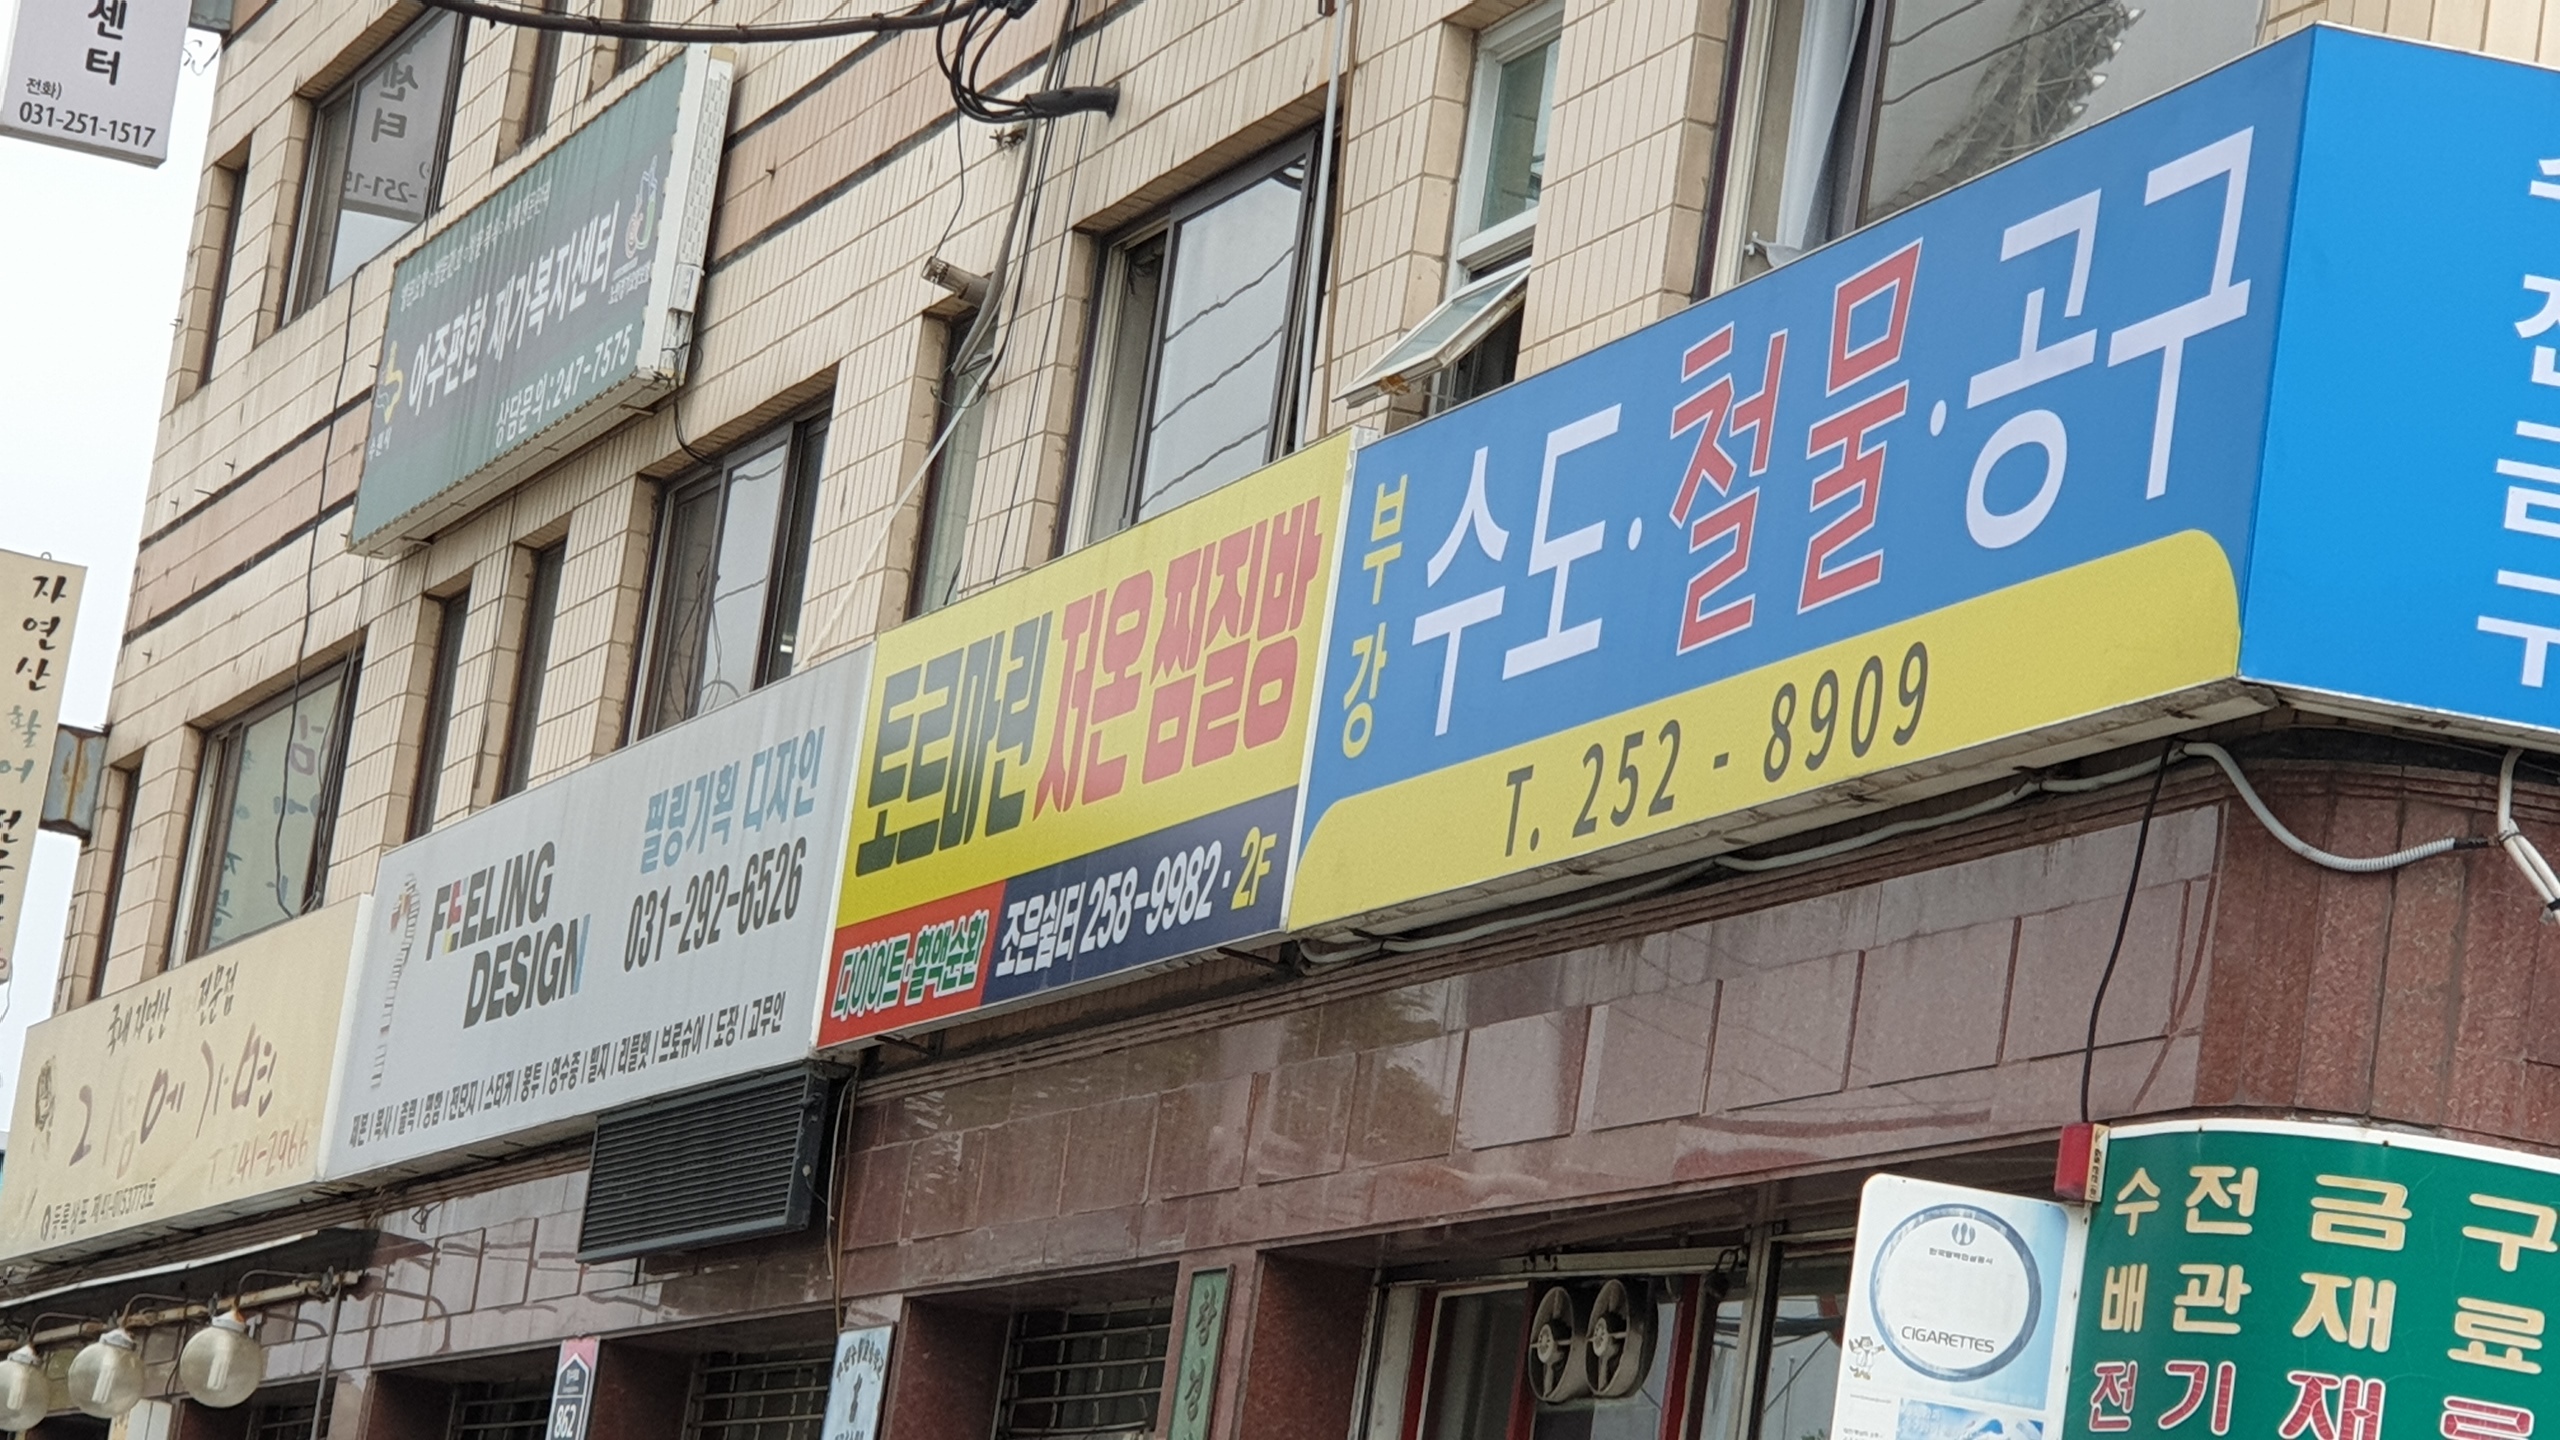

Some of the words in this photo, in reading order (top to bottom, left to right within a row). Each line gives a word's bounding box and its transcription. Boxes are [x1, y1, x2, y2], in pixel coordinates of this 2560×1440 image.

[19, 101, 157, 148] 031-251-1517
[26, 77, 63, 100] 전화)
[408, 299, 488, 417] 아주편한
[487, 199, 621, 363] 재가복지센터
[1341, 472, 1408, 760] 부강
[639, 759, 741, 875] 필링기획
[742, 725, 826, 833] 디자인
[855, 609, 1054, 878] 토르마린
[424, 840, 557, 962] FEELING
[623, 836, 808, 972] 031-292-6526
[994, 880, 1087, 978] 조은쉼터
[462, 912, 592, 1030] DESIGN
[423, 1090, 443, 1129] 명함
[448, 1079, 479, 1122] 전단지
[483, 1069, 515, 1111] 스티커
[520, 1061, 543, 1103] 봉투
[548, 1049, 581, 1096] 영수증
[658, 1014, 706, 1063] 브로슈어
[713, 1004, 740, 1048] 도장
[747, 990, 787, 1039] 고무인
[1901, 1325, 1995, 1354] CIGARETTES
[553, 1403, 577, 1439] 862
